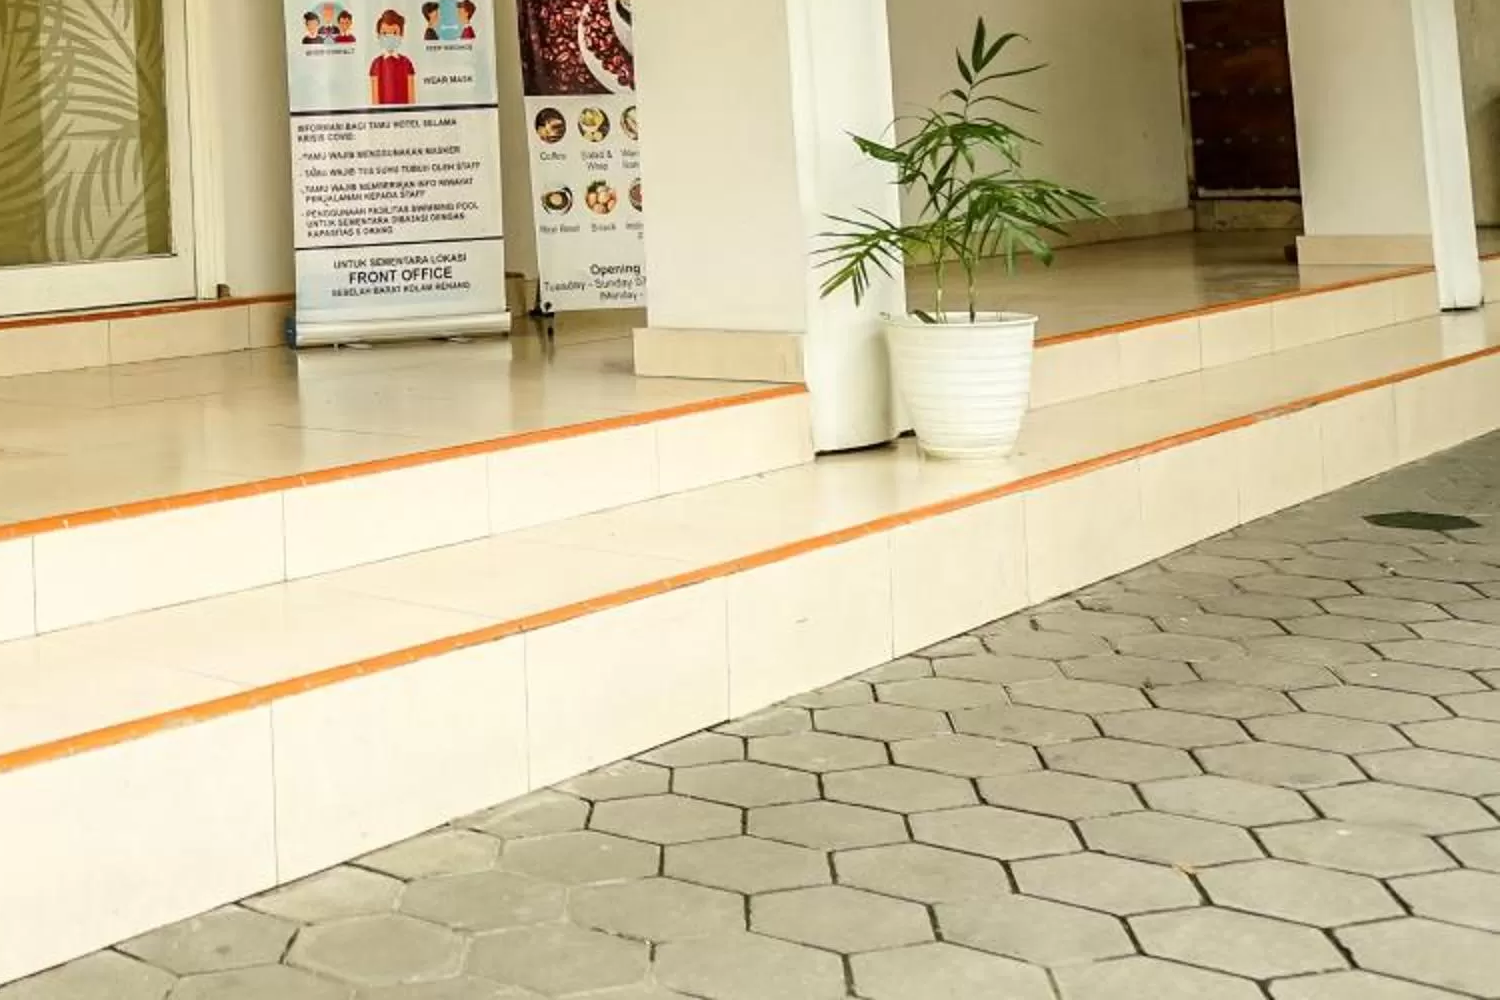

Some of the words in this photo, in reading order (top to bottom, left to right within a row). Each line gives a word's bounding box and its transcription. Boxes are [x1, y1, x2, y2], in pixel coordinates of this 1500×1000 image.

[424, 76, 449, 85] WEAR
[450, 75, 473, 83] MASK
[333, 259, 367, 269] UNTUK
[369, 255, 429, 266] SEMENTARA
[430, 252, 467, 264] LOKASI
[349, 269, 398, 284] FRONT
[401, 266, 453, 281] OFFICE
[589, 263, 641, 276] Opening
[543, 281, 586, 292] Tuesday
[594, 279, 633, 289] Sunday
